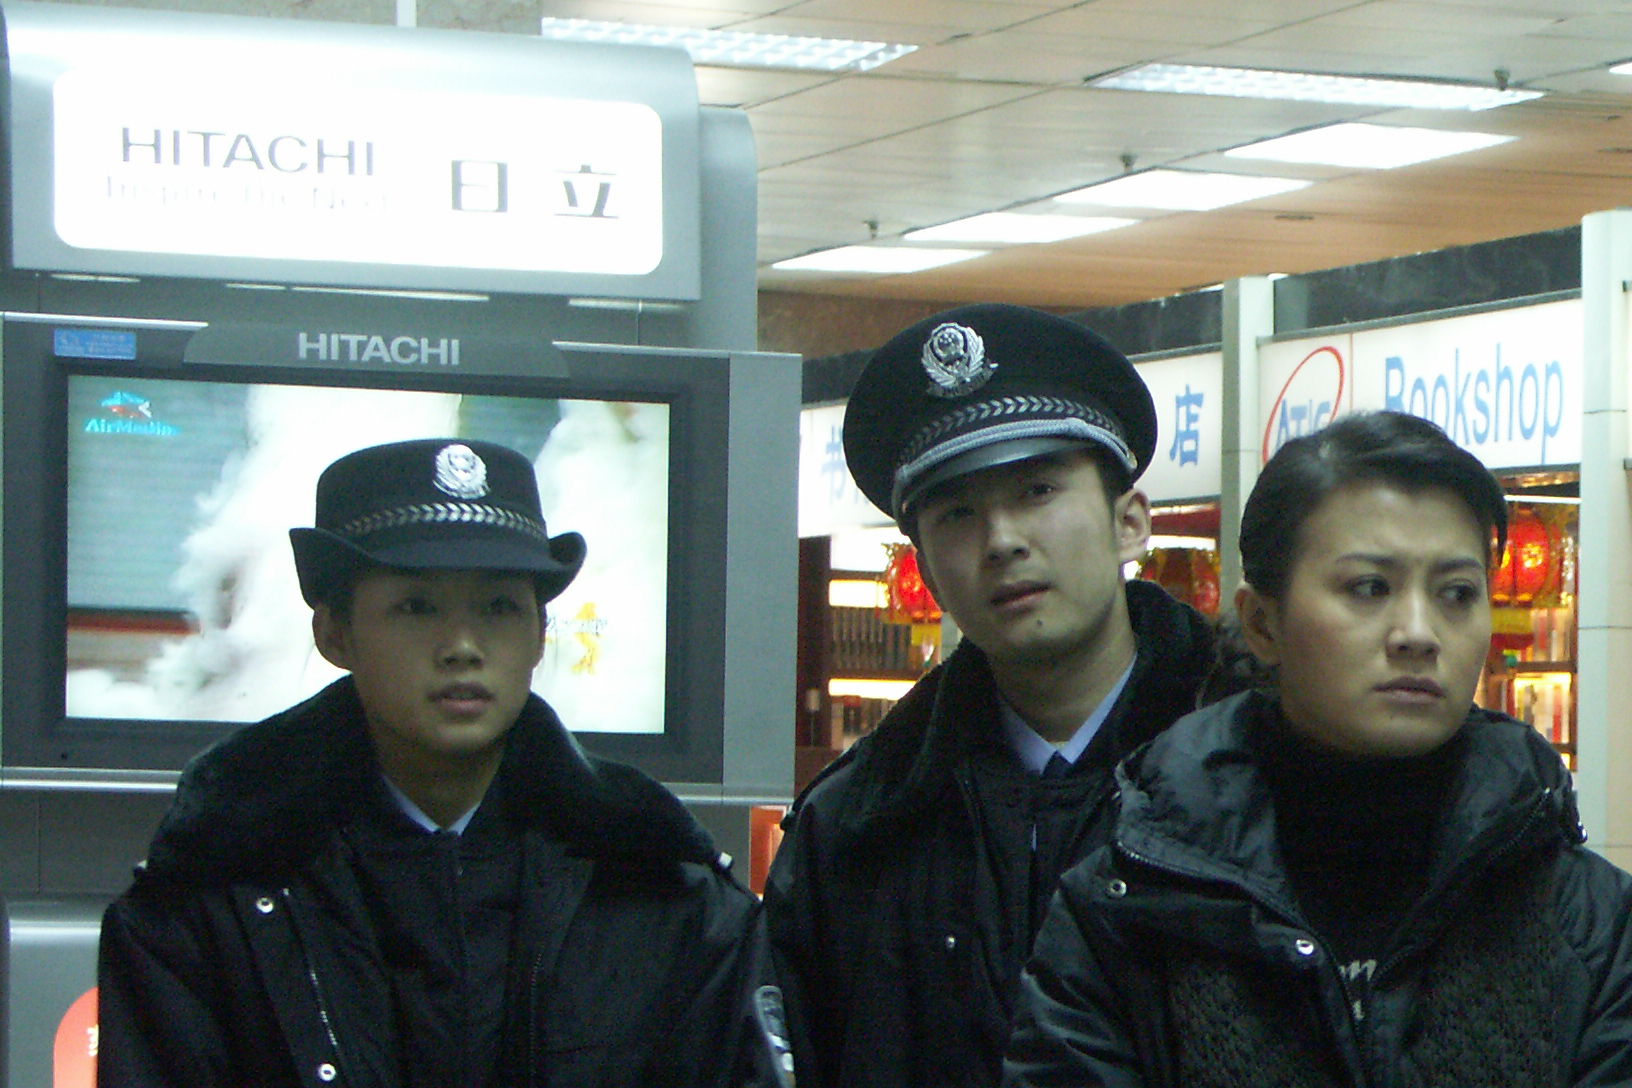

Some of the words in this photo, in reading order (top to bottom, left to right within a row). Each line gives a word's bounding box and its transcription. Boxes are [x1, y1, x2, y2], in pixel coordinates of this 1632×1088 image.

[121, 127, 374, 176] HITACHI
[451, 160, 619, 218] 日立
[299, 332, 460, 366] HITACHI
[1169, 384, 1204, 467] 店
[1386, 343, 1563, 464] Bookshop
